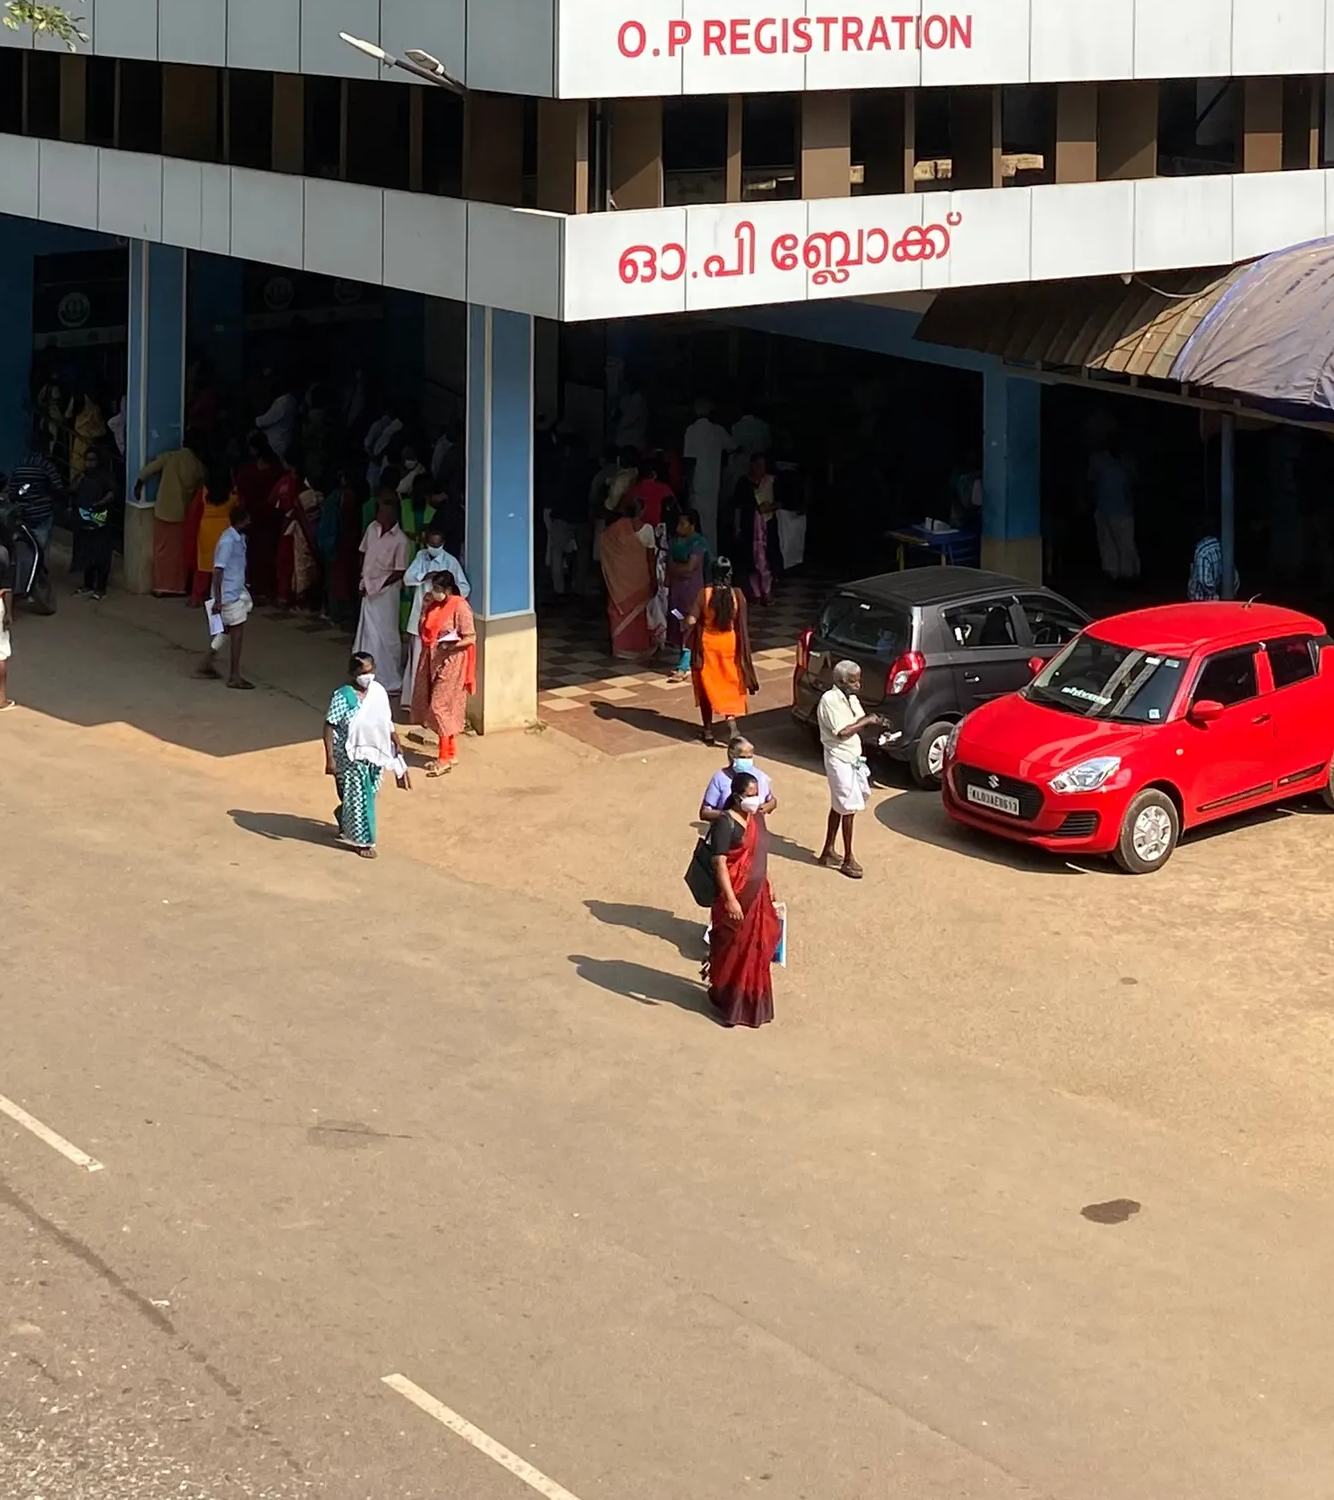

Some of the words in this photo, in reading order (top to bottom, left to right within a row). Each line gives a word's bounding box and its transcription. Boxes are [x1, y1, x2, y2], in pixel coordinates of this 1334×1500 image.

[703, 14, 972, 56] REGISTRATION
[619, 221, 756, 284] ഓ.പി
[771, 211, 962, 285] ബ്ലോക്ക്
